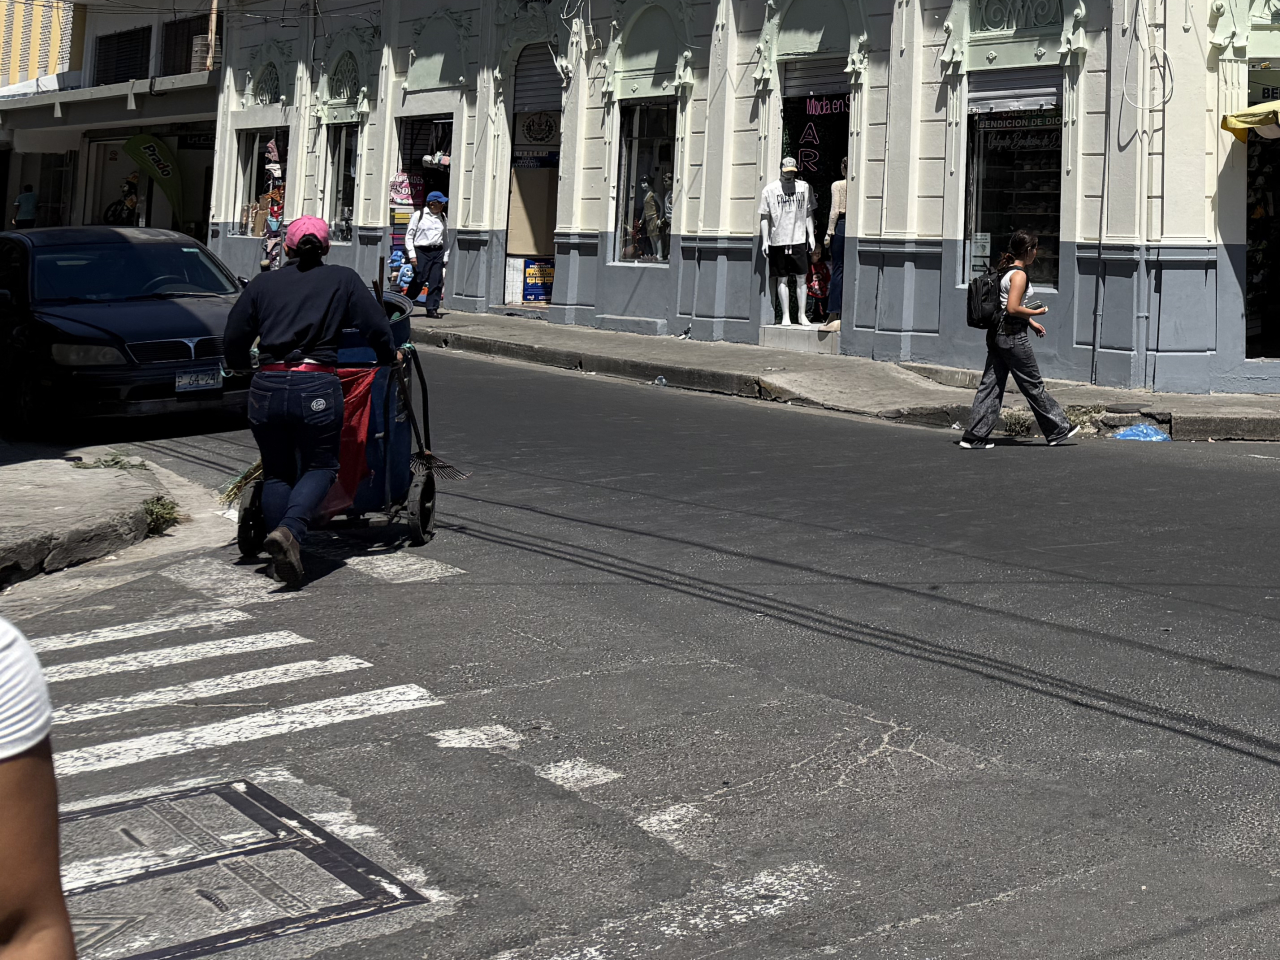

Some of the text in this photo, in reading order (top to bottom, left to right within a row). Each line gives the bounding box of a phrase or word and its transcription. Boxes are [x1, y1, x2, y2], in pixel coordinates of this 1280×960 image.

[832, 100, 844, 113] en
[1031, 118, 1043, 126] DE
[141, 143, 172, 178] Prado
